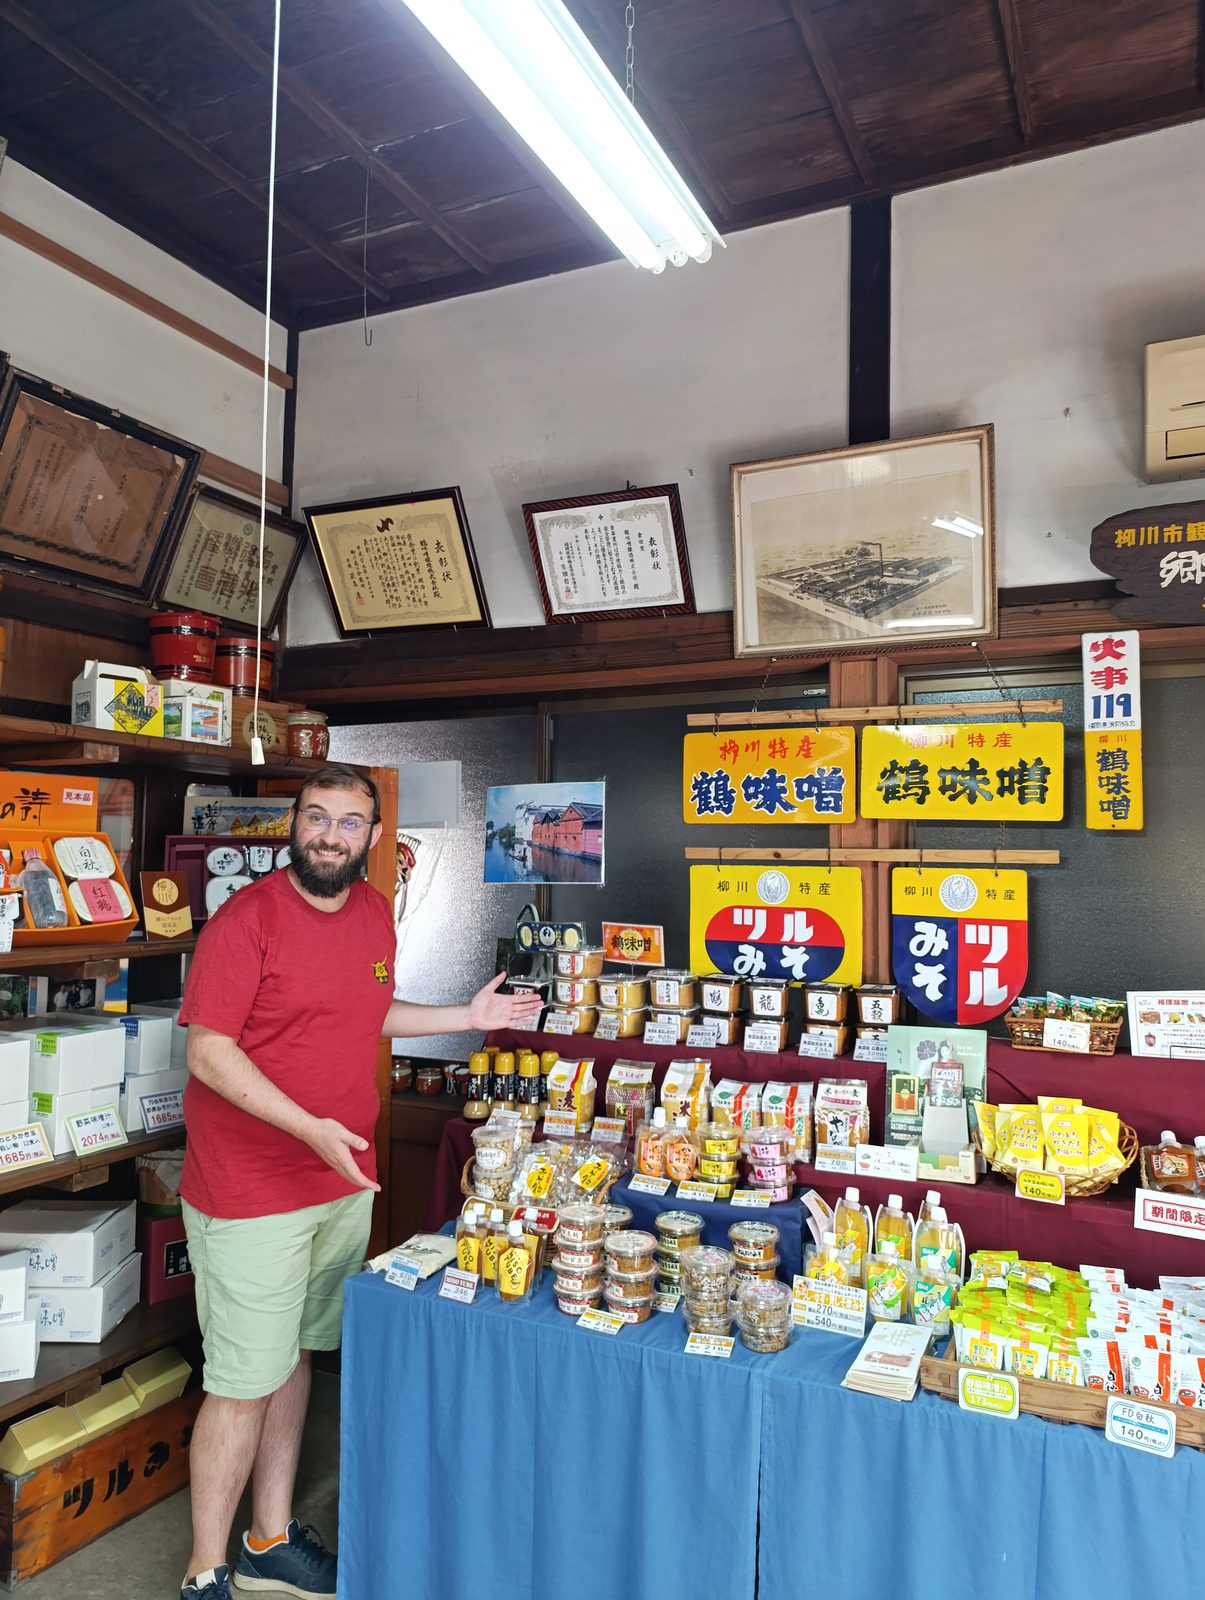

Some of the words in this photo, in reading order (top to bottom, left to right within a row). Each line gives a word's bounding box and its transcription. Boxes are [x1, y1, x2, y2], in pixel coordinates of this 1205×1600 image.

[1089, 635, 1127, 692] 火事
[1090, 693, 1132, 721] 119
[718, 735, 818, 766] 柳川特産
[909, 731, 1014, 751] 柳川特産
[64, 791, 93, 802] 見本品
[690, 767, 846, 816] 鶴味噌
[876, 756, 1052, 806] 鶴味噌
[1095, 746, 1132, 821] 鶴味噌
[717, 880, 748, 895] 柳川
[799, 882, 831, 898] 特産
[903, 885, 933, 898] 柳川
[985, 888, 1017, 902] 特産
[732, 907, 814, 944] ツル
[733, 943, 811, 980] みそ
[908, 920, 950, 1003] みそ
[964, 923, 1009, 1007] ツル
[76, 1112, 113, 1131] 野菜味噌汁
[1151, 1204, 1205, 1226] 期間限定
